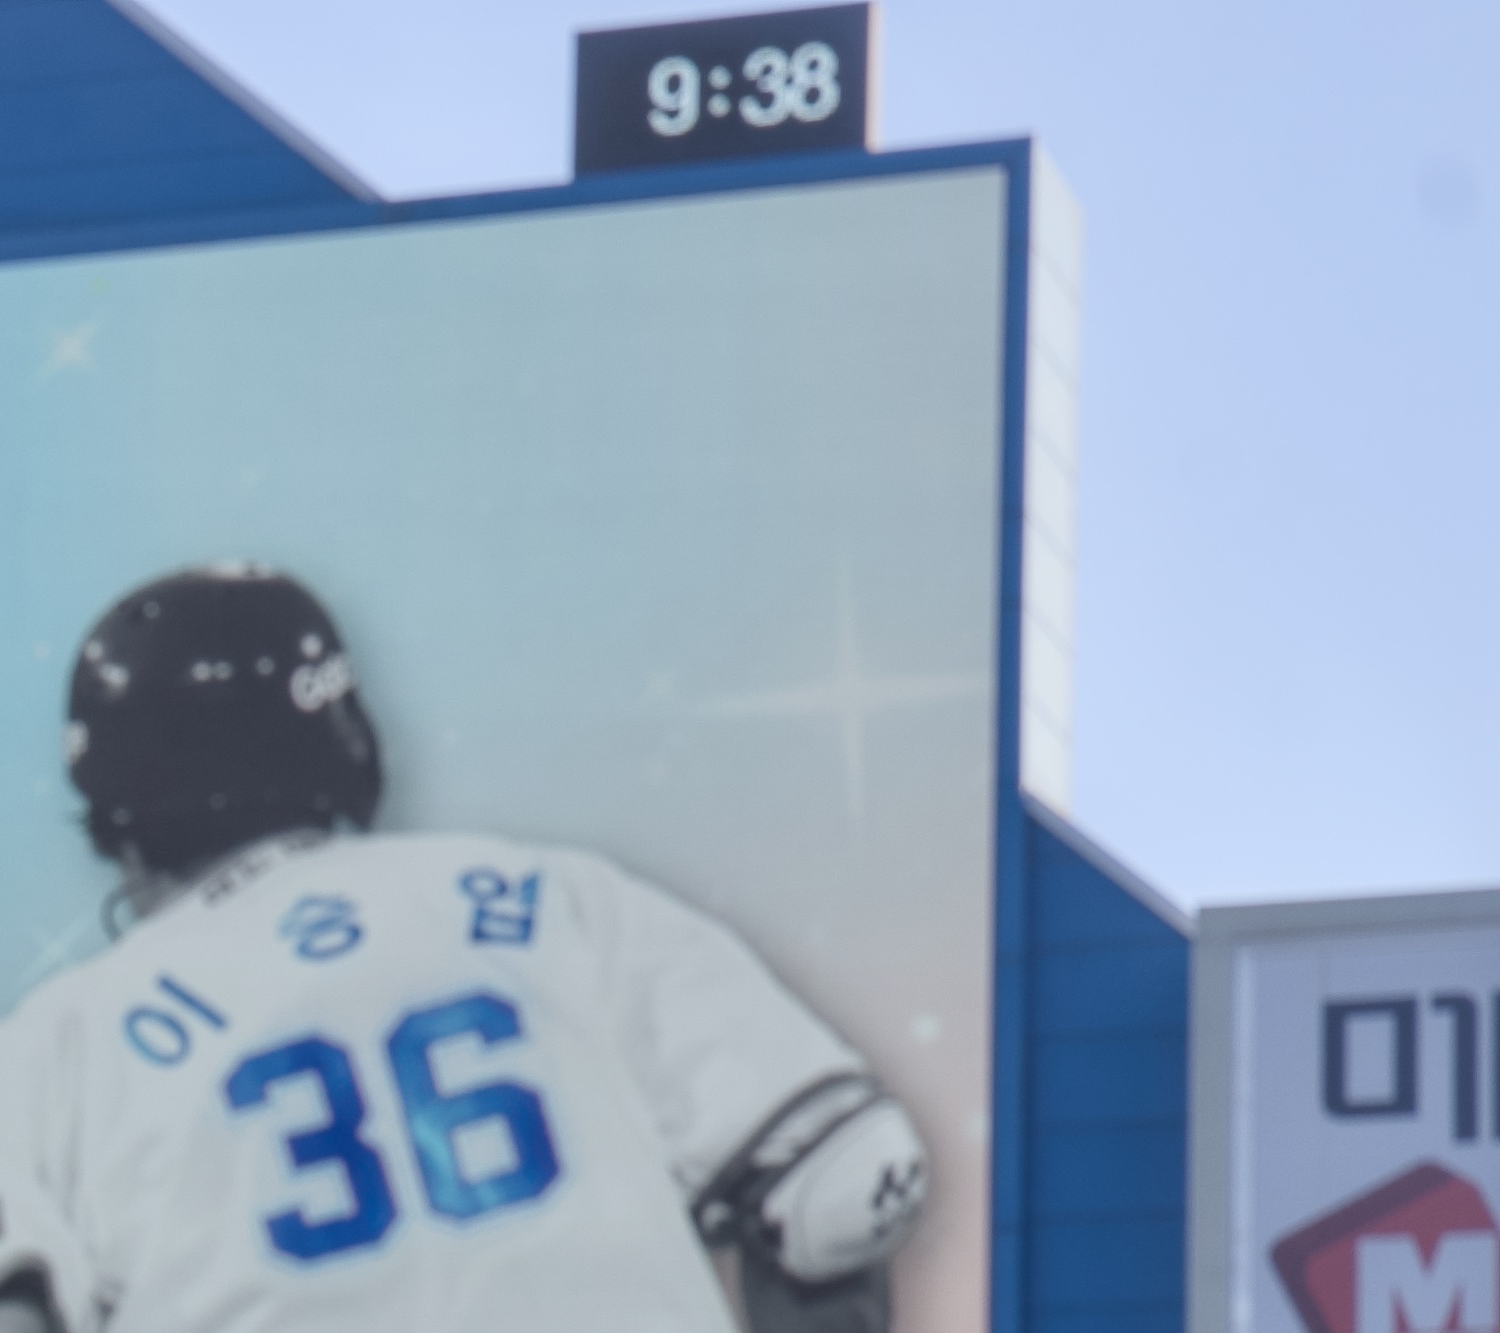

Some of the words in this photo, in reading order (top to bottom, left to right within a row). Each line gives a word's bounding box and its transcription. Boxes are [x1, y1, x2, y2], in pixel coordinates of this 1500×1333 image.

[647, 42, 841, 137] 9:38
[222, 985, 562, 1266] 36
[1320, 985, 1500, 1142] 미
